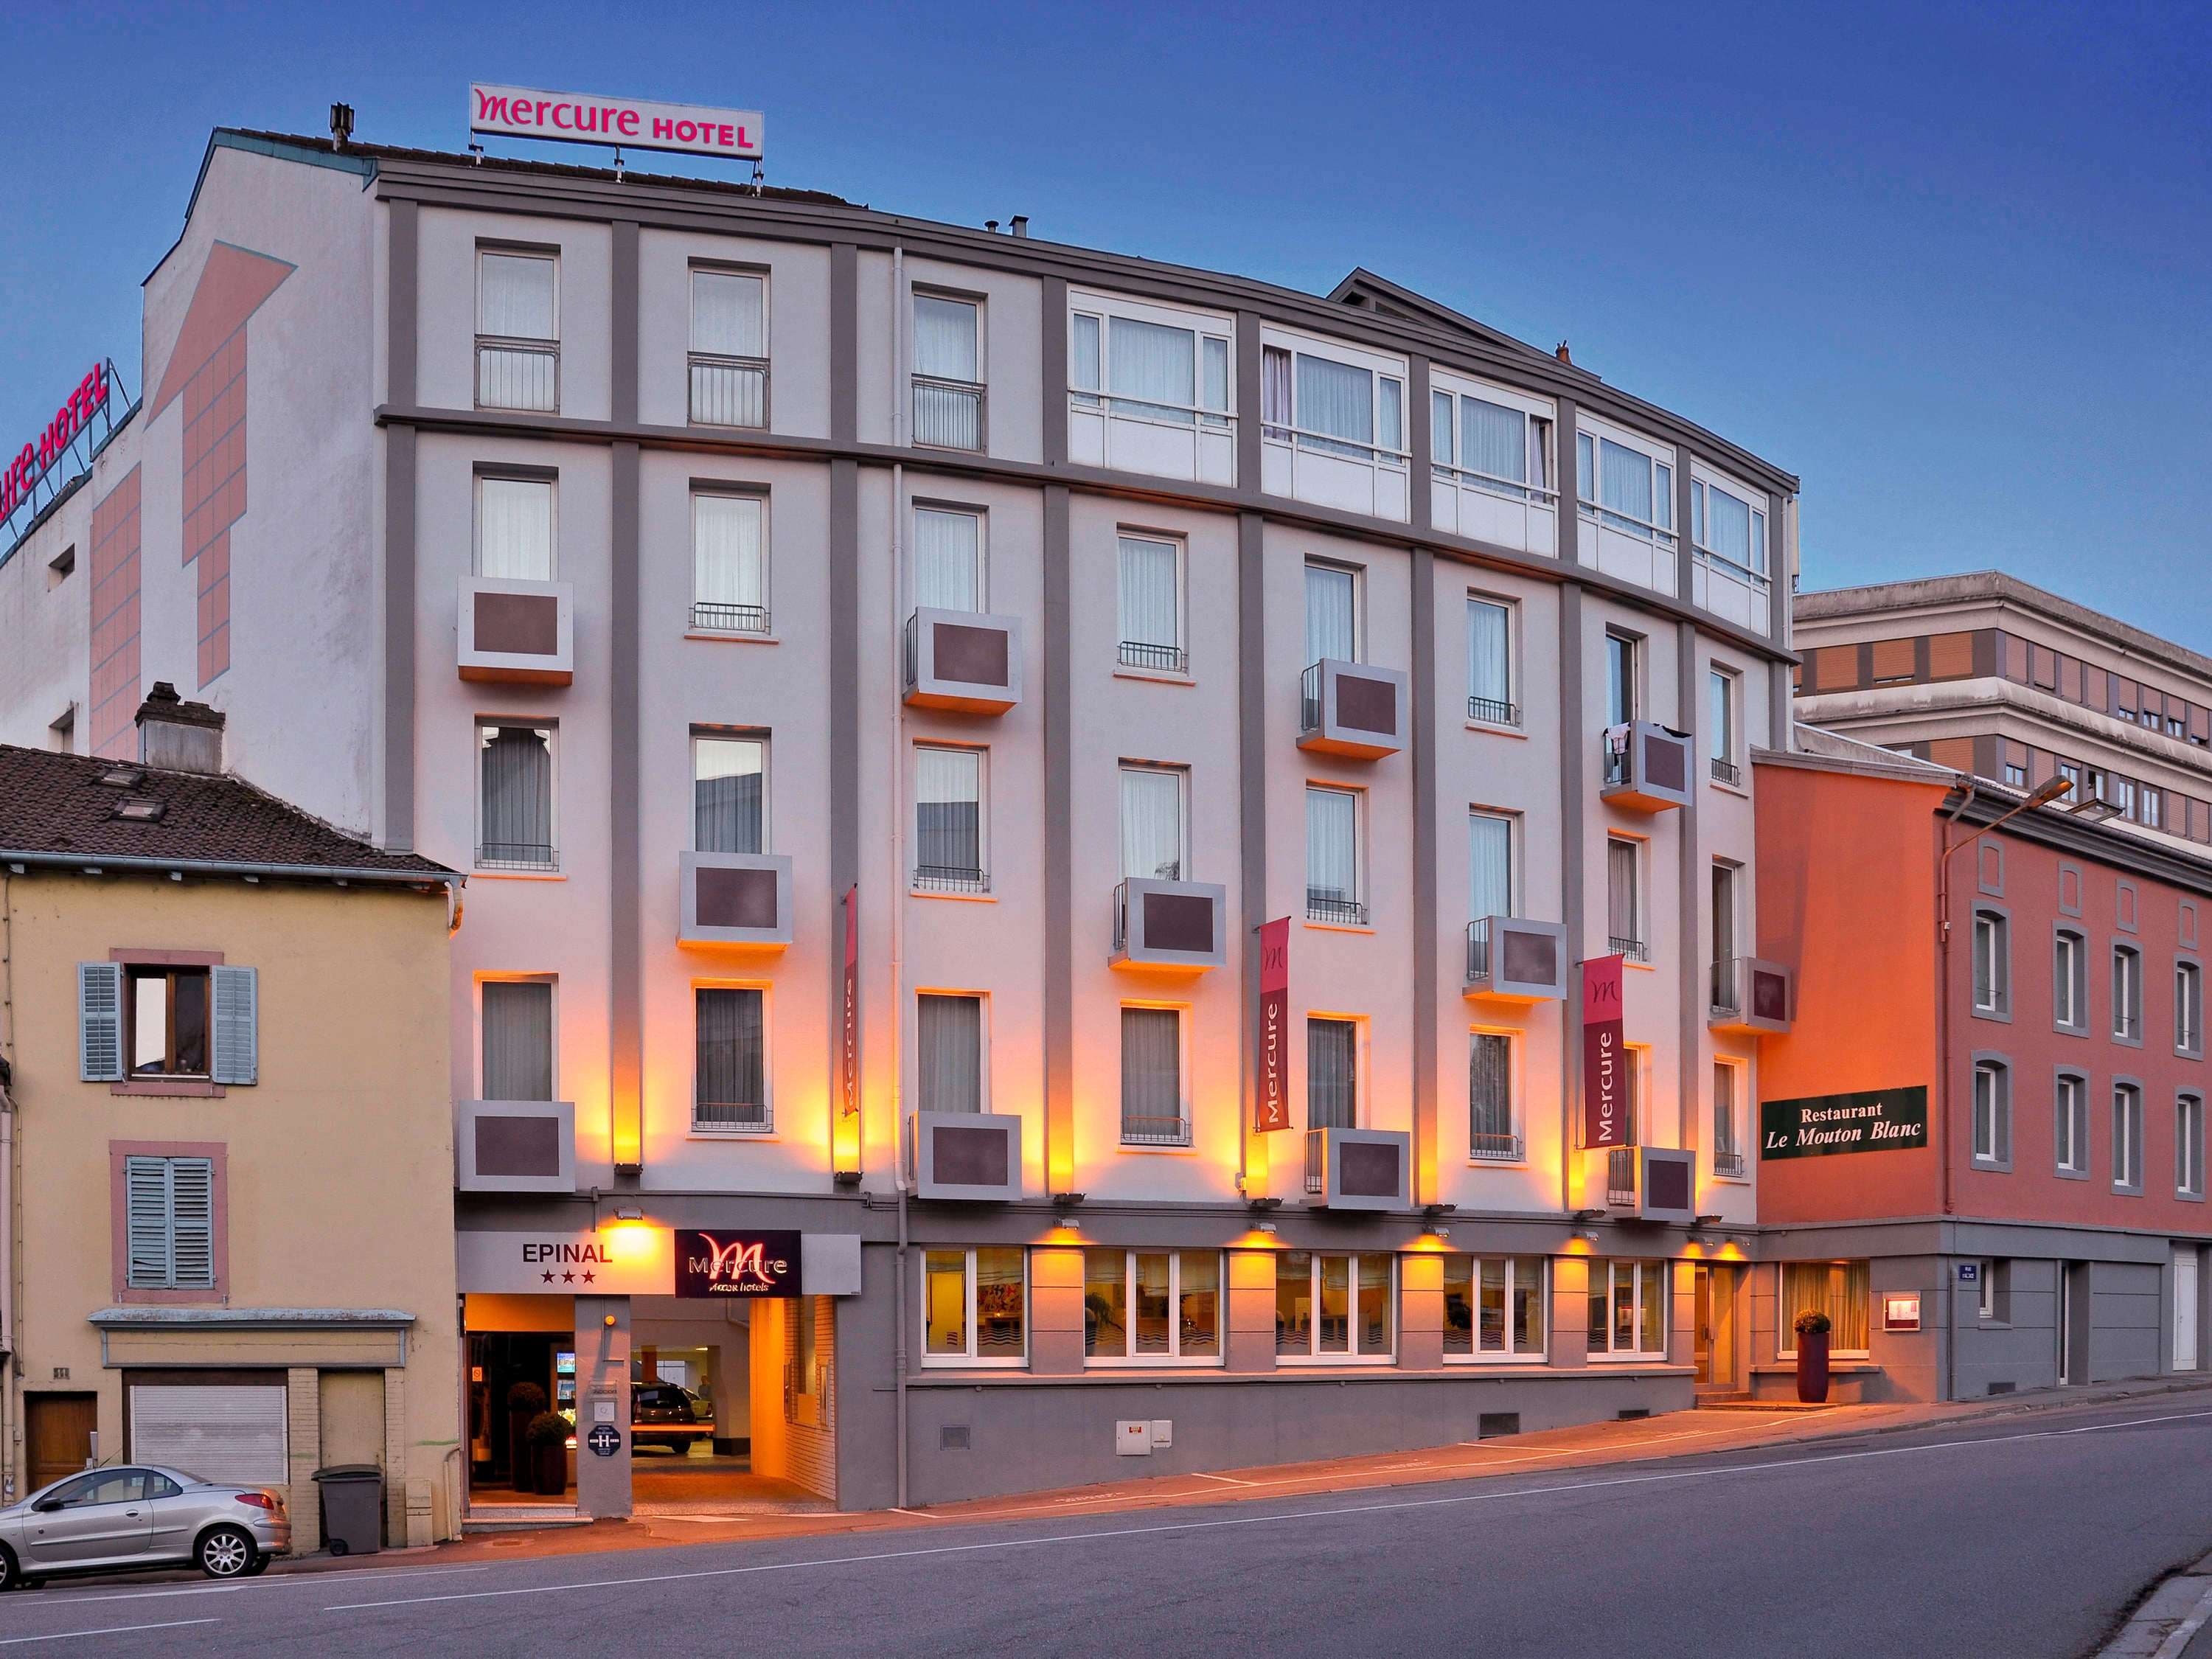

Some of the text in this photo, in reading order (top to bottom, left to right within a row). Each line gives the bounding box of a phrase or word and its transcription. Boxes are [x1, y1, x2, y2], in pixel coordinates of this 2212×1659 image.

[653, 117, 754, 148] HOTEL
[40, 362, 107, 470] HOTEL
[1267, 1002, 1279, 1124] Mercure
[1599, 1032, 1613, 1142] Mercure
[1801, 1102, 1882, 1123] Restaurant
[1766, 1121, 1921, 1149] Le Mouton Blanc
[523, 1244, 613, 1263] EPINAL
[689, 1256, 787, 1274] Mercure
[740, 1281, 769, 1292] hotels
[599, 1435, 609, 1447] H
